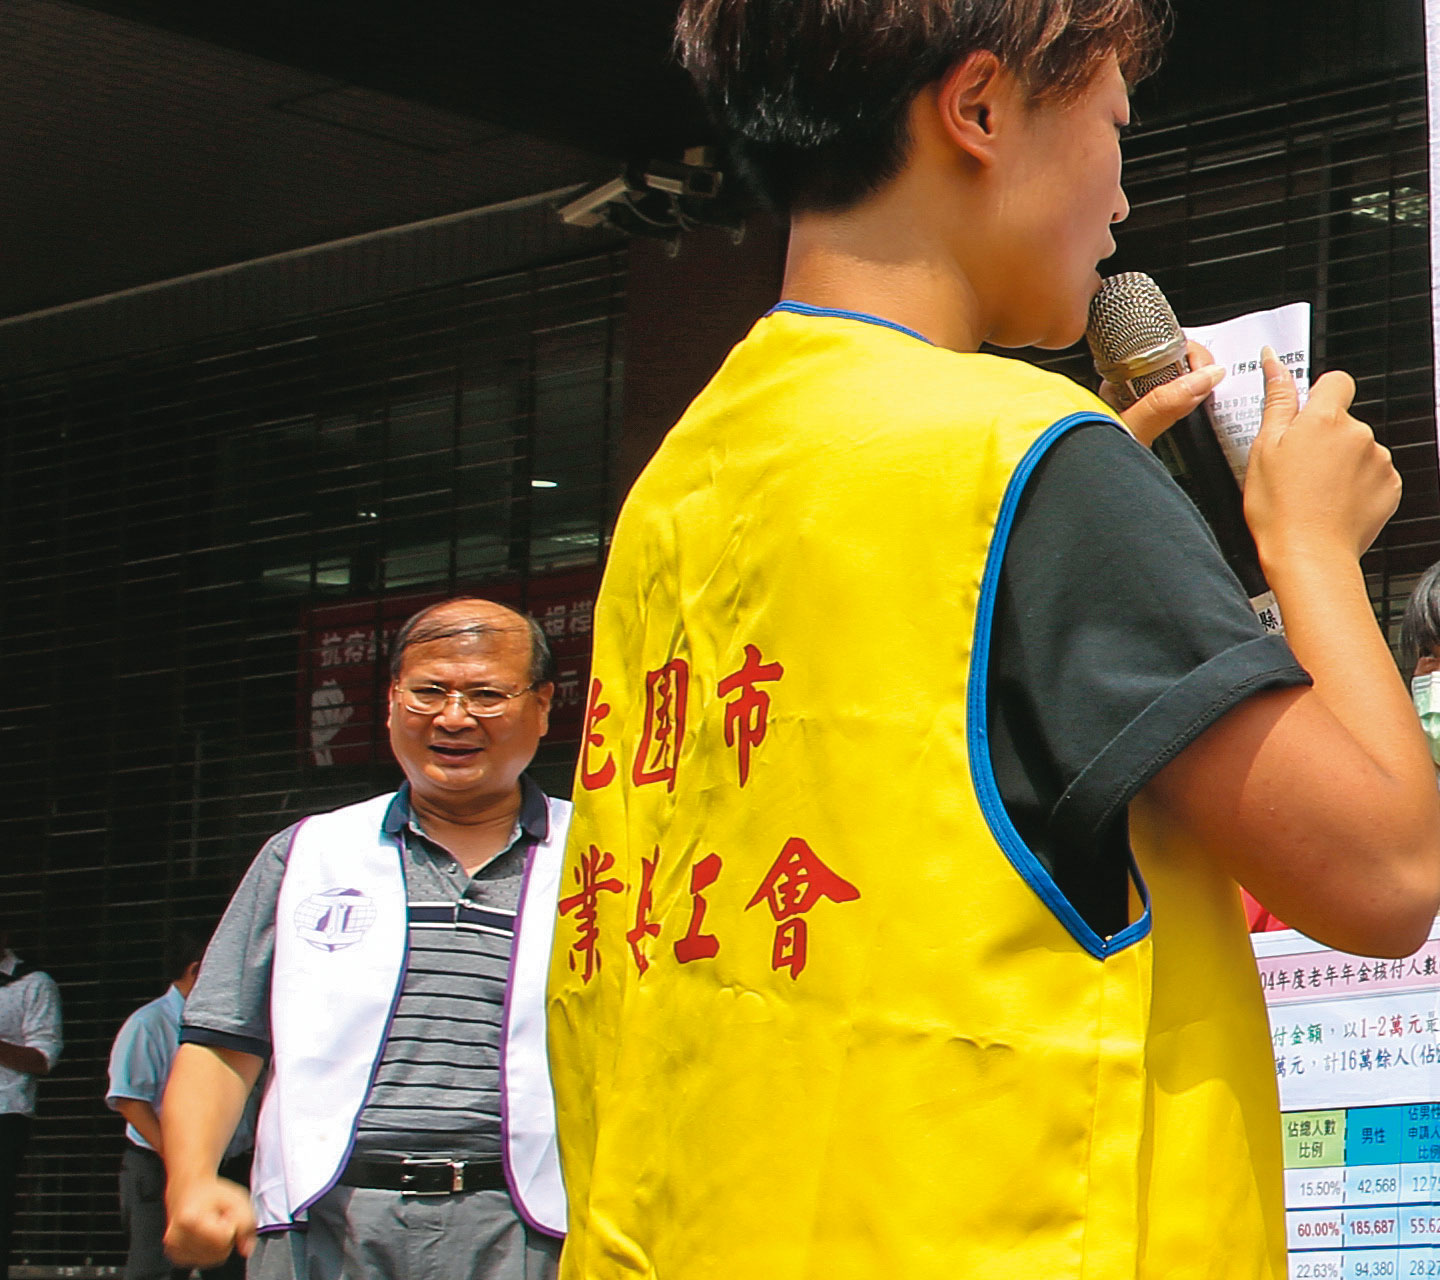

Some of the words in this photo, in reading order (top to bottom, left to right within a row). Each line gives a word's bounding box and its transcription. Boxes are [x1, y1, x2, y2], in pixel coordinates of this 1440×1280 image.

[1361, 1127, 1386, 1145] 男性
[1299, 1142, 1324, 1159] 比例
[1299, 1181, 1341, 1197] 15.50%
[1357, 1178, 1397, 1194] 42,568
[1297, 1222, 1340, 1238] 60.00%
[1350, 1219, 1395, 1236] 185,687
[1296, 1263, 1338, 1279] 22.63%
[1355, 1261, 1394, 1277] 94,380
